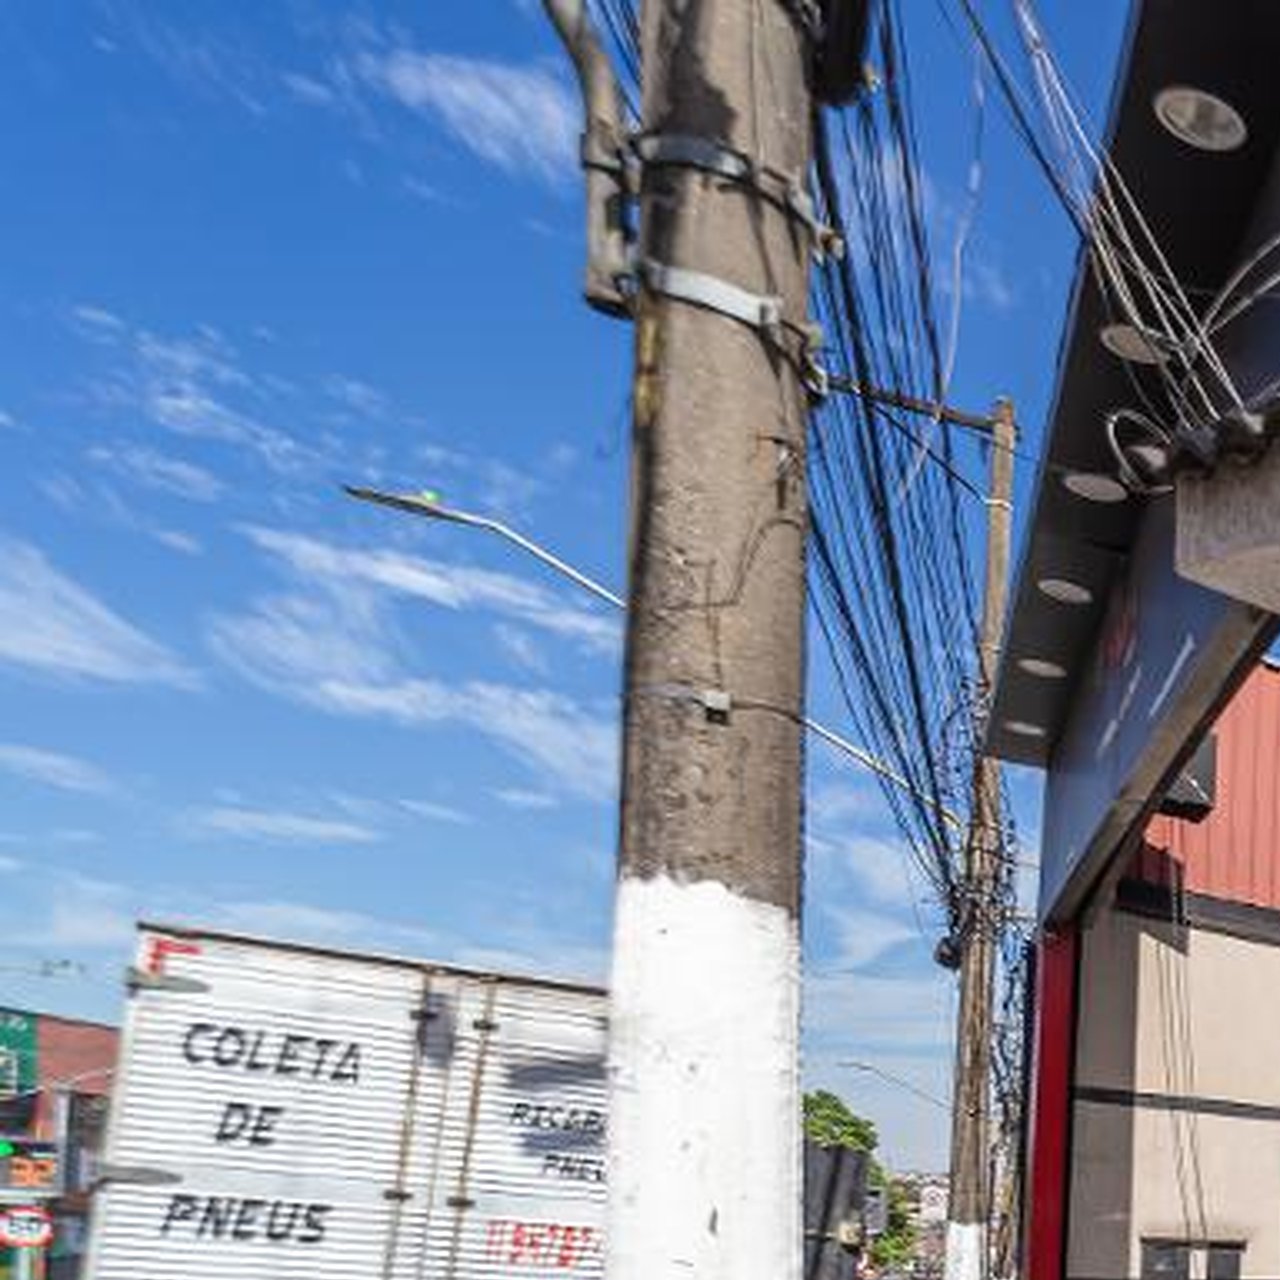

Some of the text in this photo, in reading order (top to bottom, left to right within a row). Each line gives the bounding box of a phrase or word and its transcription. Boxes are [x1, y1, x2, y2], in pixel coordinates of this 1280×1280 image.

[182, 1022, 360, 1083] COLETA
[214, 1101, 284, 1146] DE
[160, 1194, 333, 1243] PNEUS
